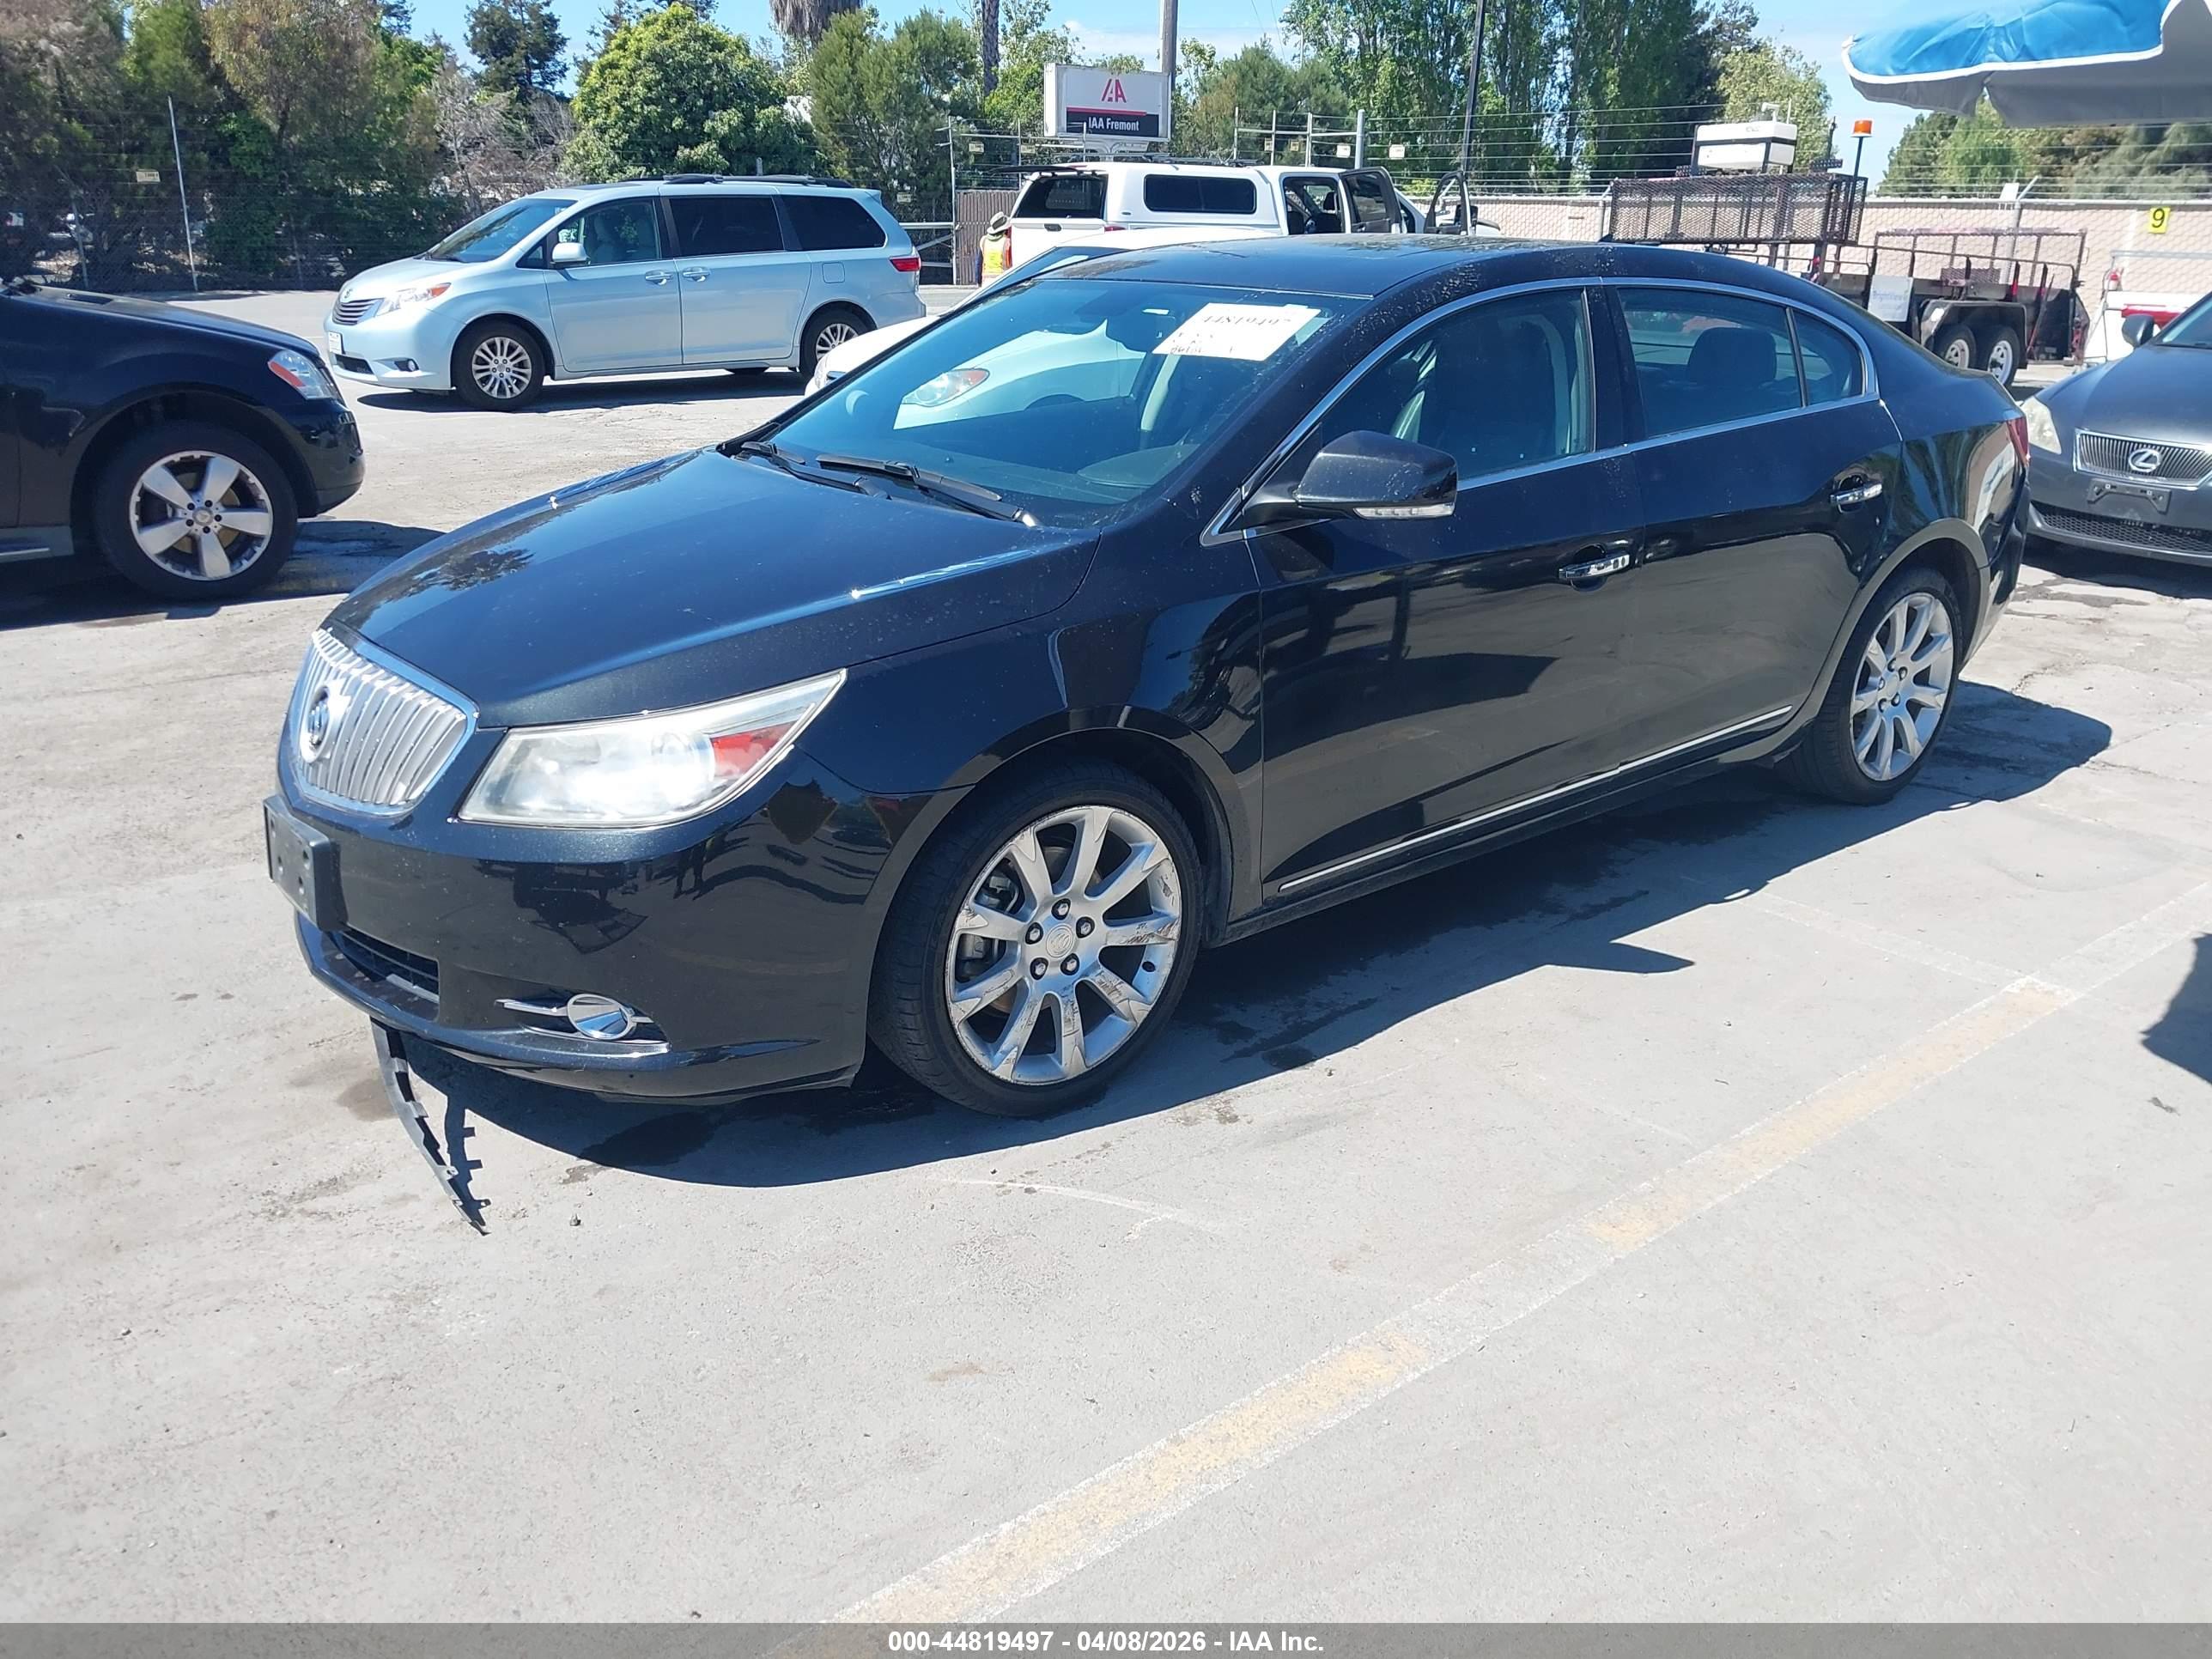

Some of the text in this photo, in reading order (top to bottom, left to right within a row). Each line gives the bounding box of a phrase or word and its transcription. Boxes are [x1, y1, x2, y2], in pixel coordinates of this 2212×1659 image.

[1088, 116, 1140, 131] IAA Fremont
[2151, 208, 2166, 228] 9
